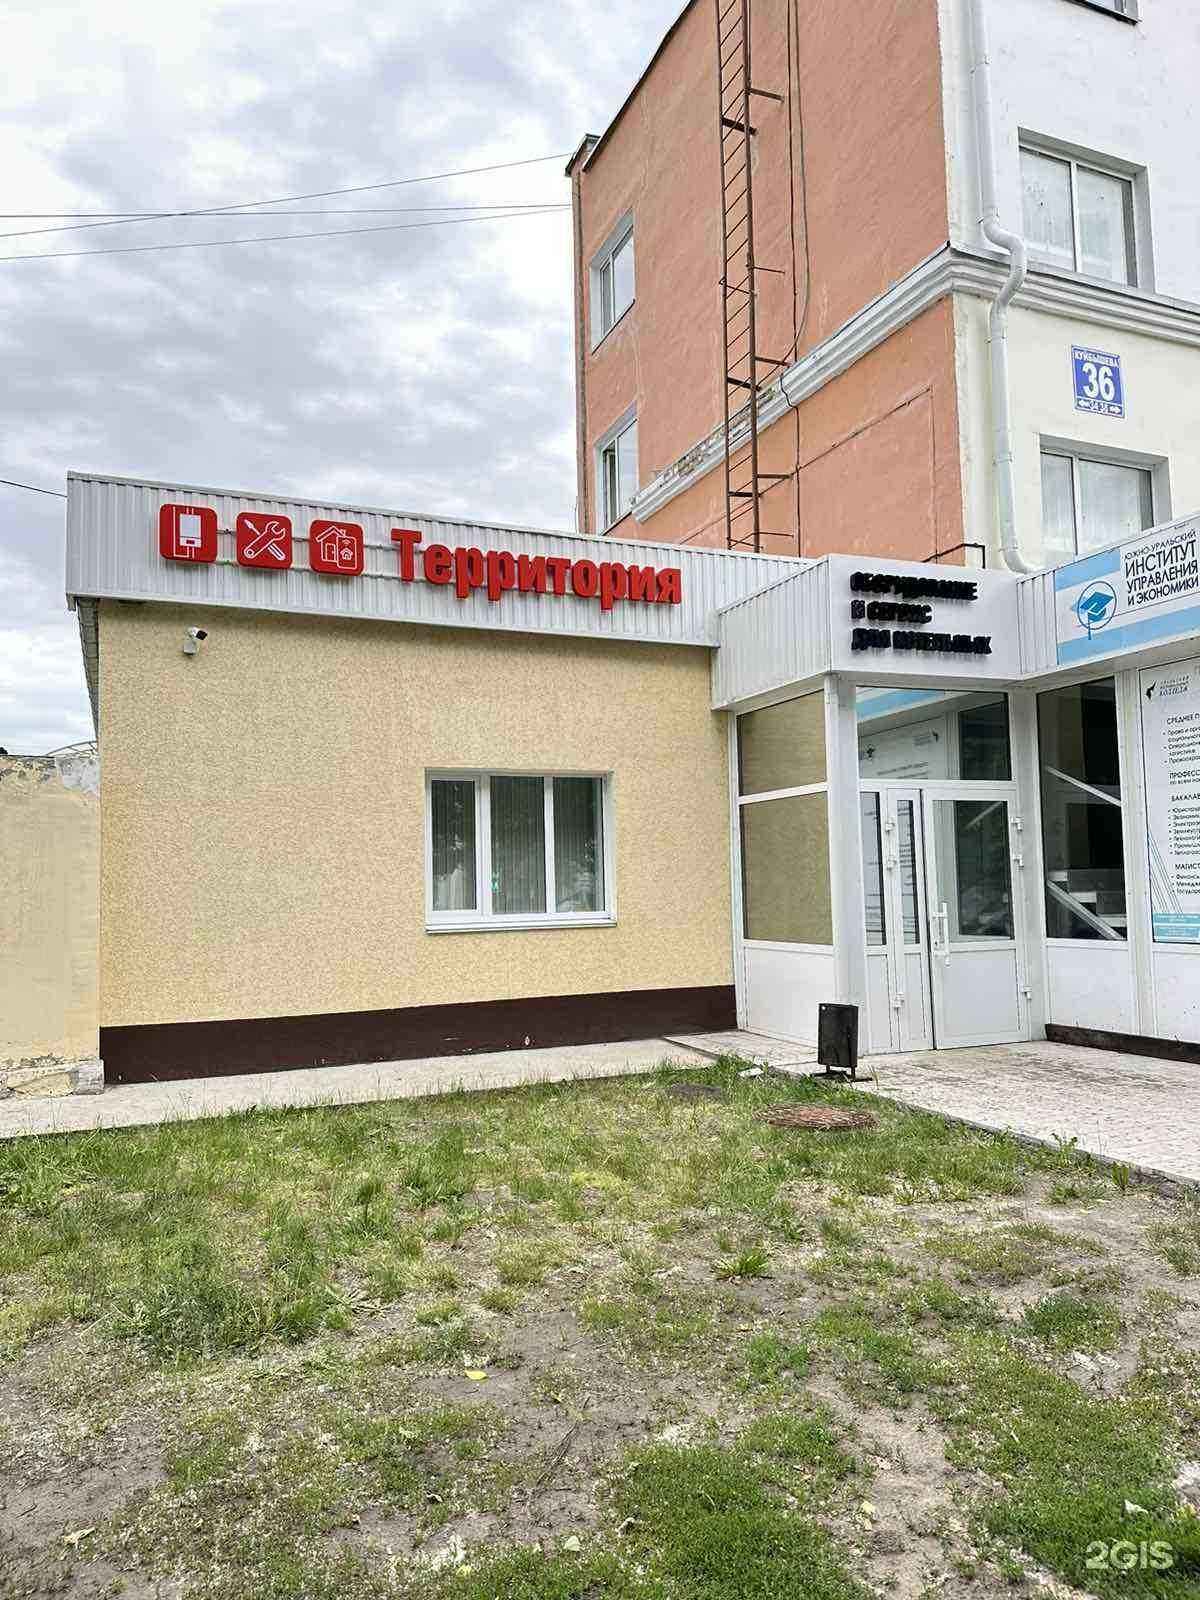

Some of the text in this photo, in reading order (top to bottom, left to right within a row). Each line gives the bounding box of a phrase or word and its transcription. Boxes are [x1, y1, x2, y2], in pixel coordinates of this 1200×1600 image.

[1082, 362, 1115, 402] 36
[391, 528, 682, 610] Территория
[1125, 539, 1196, 578] ИНСТИТУТ
[1127, 560, 1198, 594] УПРАВЛЕНИЯ
[1136, 575, 1199, 604] ЭКОНОМИКИ
